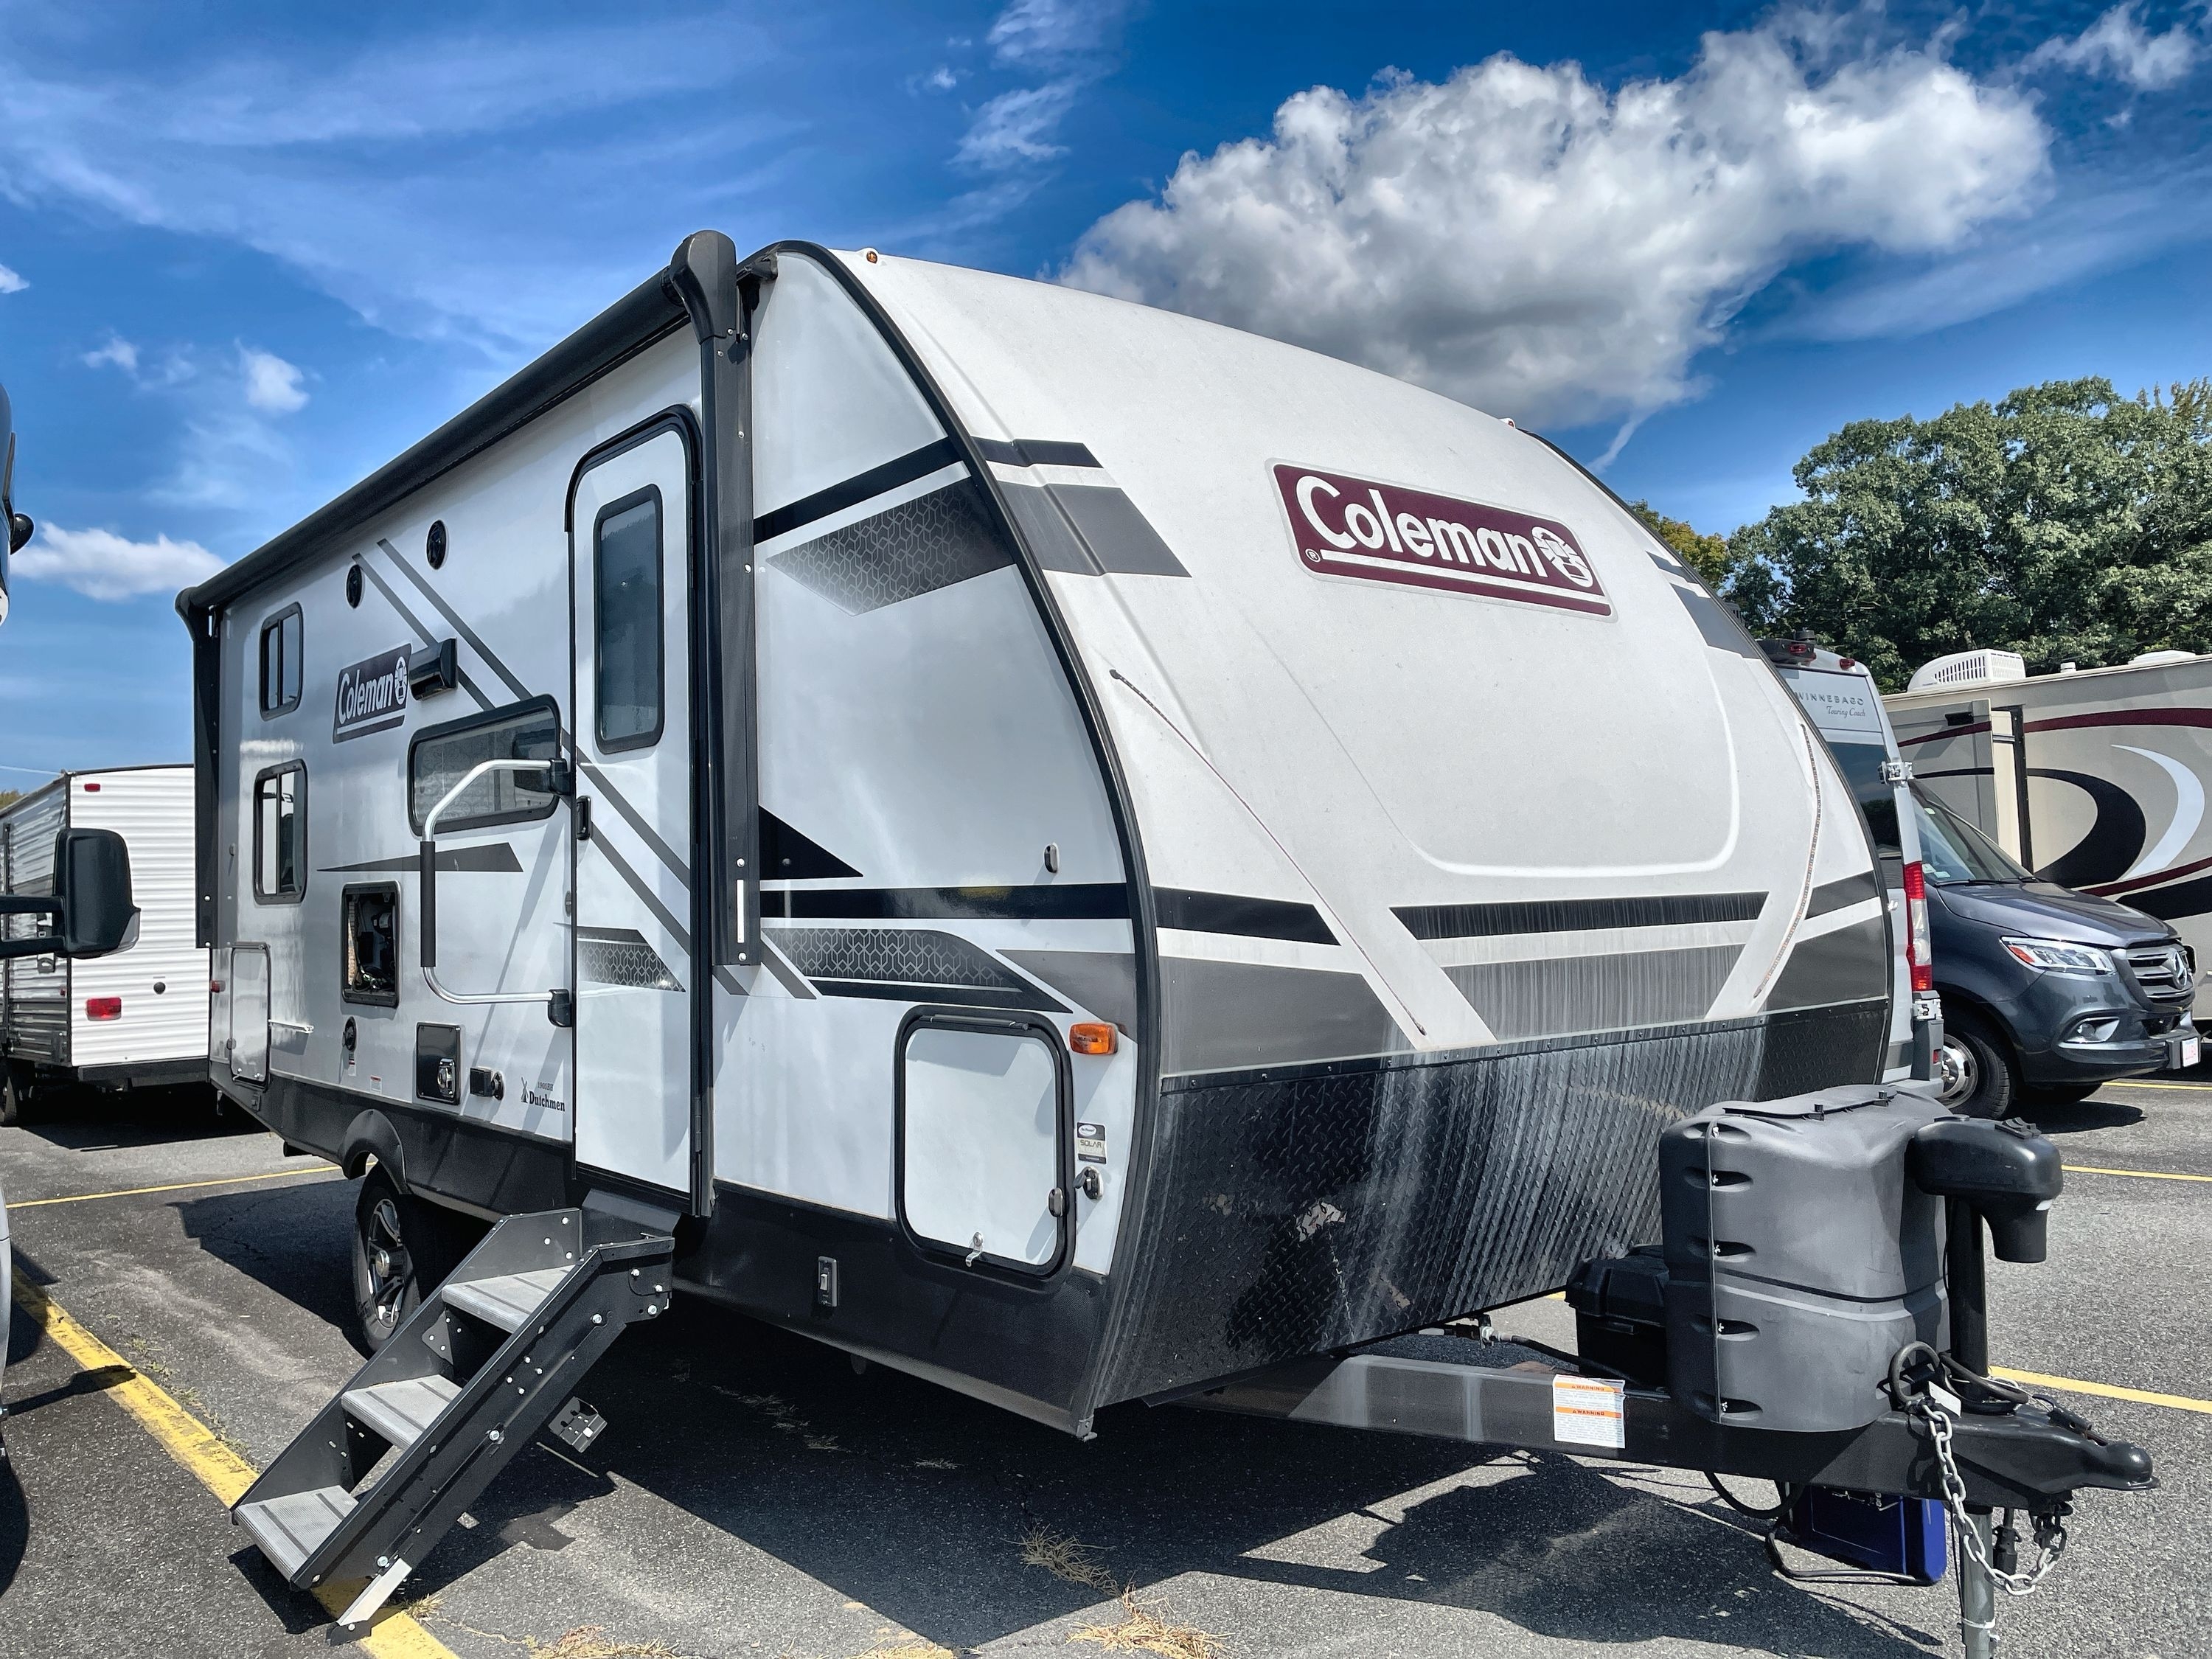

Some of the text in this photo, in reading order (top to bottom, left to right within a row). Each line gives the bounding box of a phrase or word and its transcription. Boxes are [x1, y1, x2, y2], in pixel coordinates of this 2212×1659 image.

[1296, 475, 1548, 578] Coleman
[338, 669, 394, 725] Coleman
[1826, 706, 1866, 719] Touring Coach
[529, 1091, 566, 1112] Dutchmen
[1079, 1139, 1102, 1149] SOLAR
[1576, 1384, 1604, 1392] WARNING
